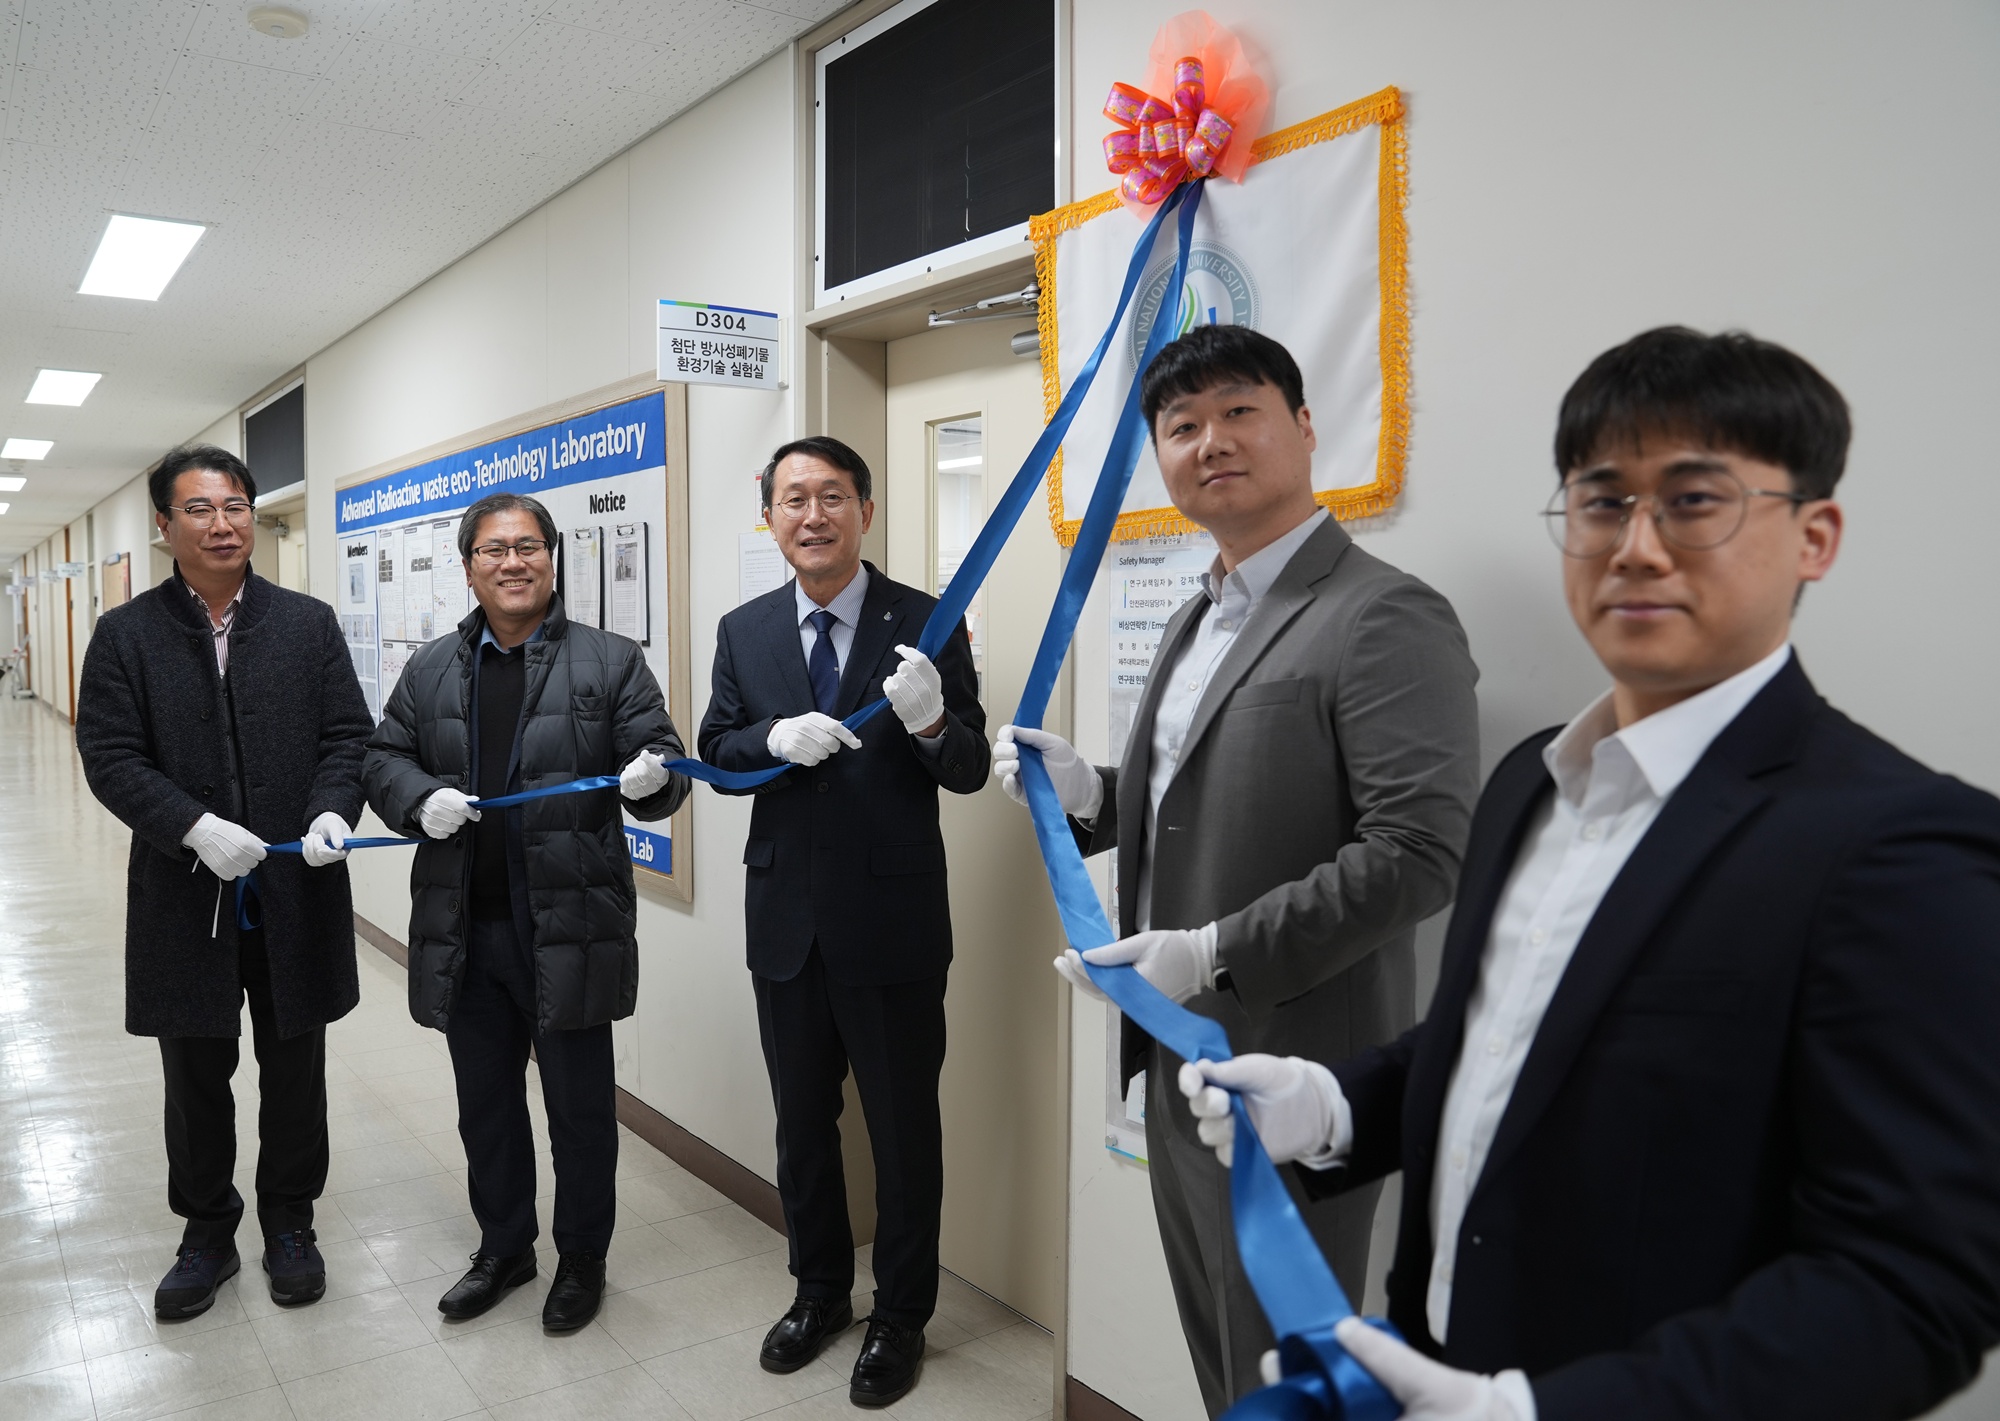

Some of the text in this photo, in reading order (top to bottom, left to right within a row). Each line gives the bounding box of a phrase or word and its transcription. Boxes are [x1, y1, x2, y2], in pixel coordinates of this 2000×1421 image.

[1137, 254, 1247, 332] NATION UNIVERSITY
[696, 311, 746, 331] D304
[671, 338, 770, 363] 첨단 방사성폐기물
[677, 355, 764, 379] 환경기술 실험실
[341, 490, 375, 523] Advanced
[376, 479, 421, 513] Radioactive
[422, 473, 450, 502] waste
[551, 421, 647, 470] Laboratory
[589, 490, 626, 514] Notice
[347, 541, 368, 558] Members
[1119, 556, 1165, 567] Safety Manager
